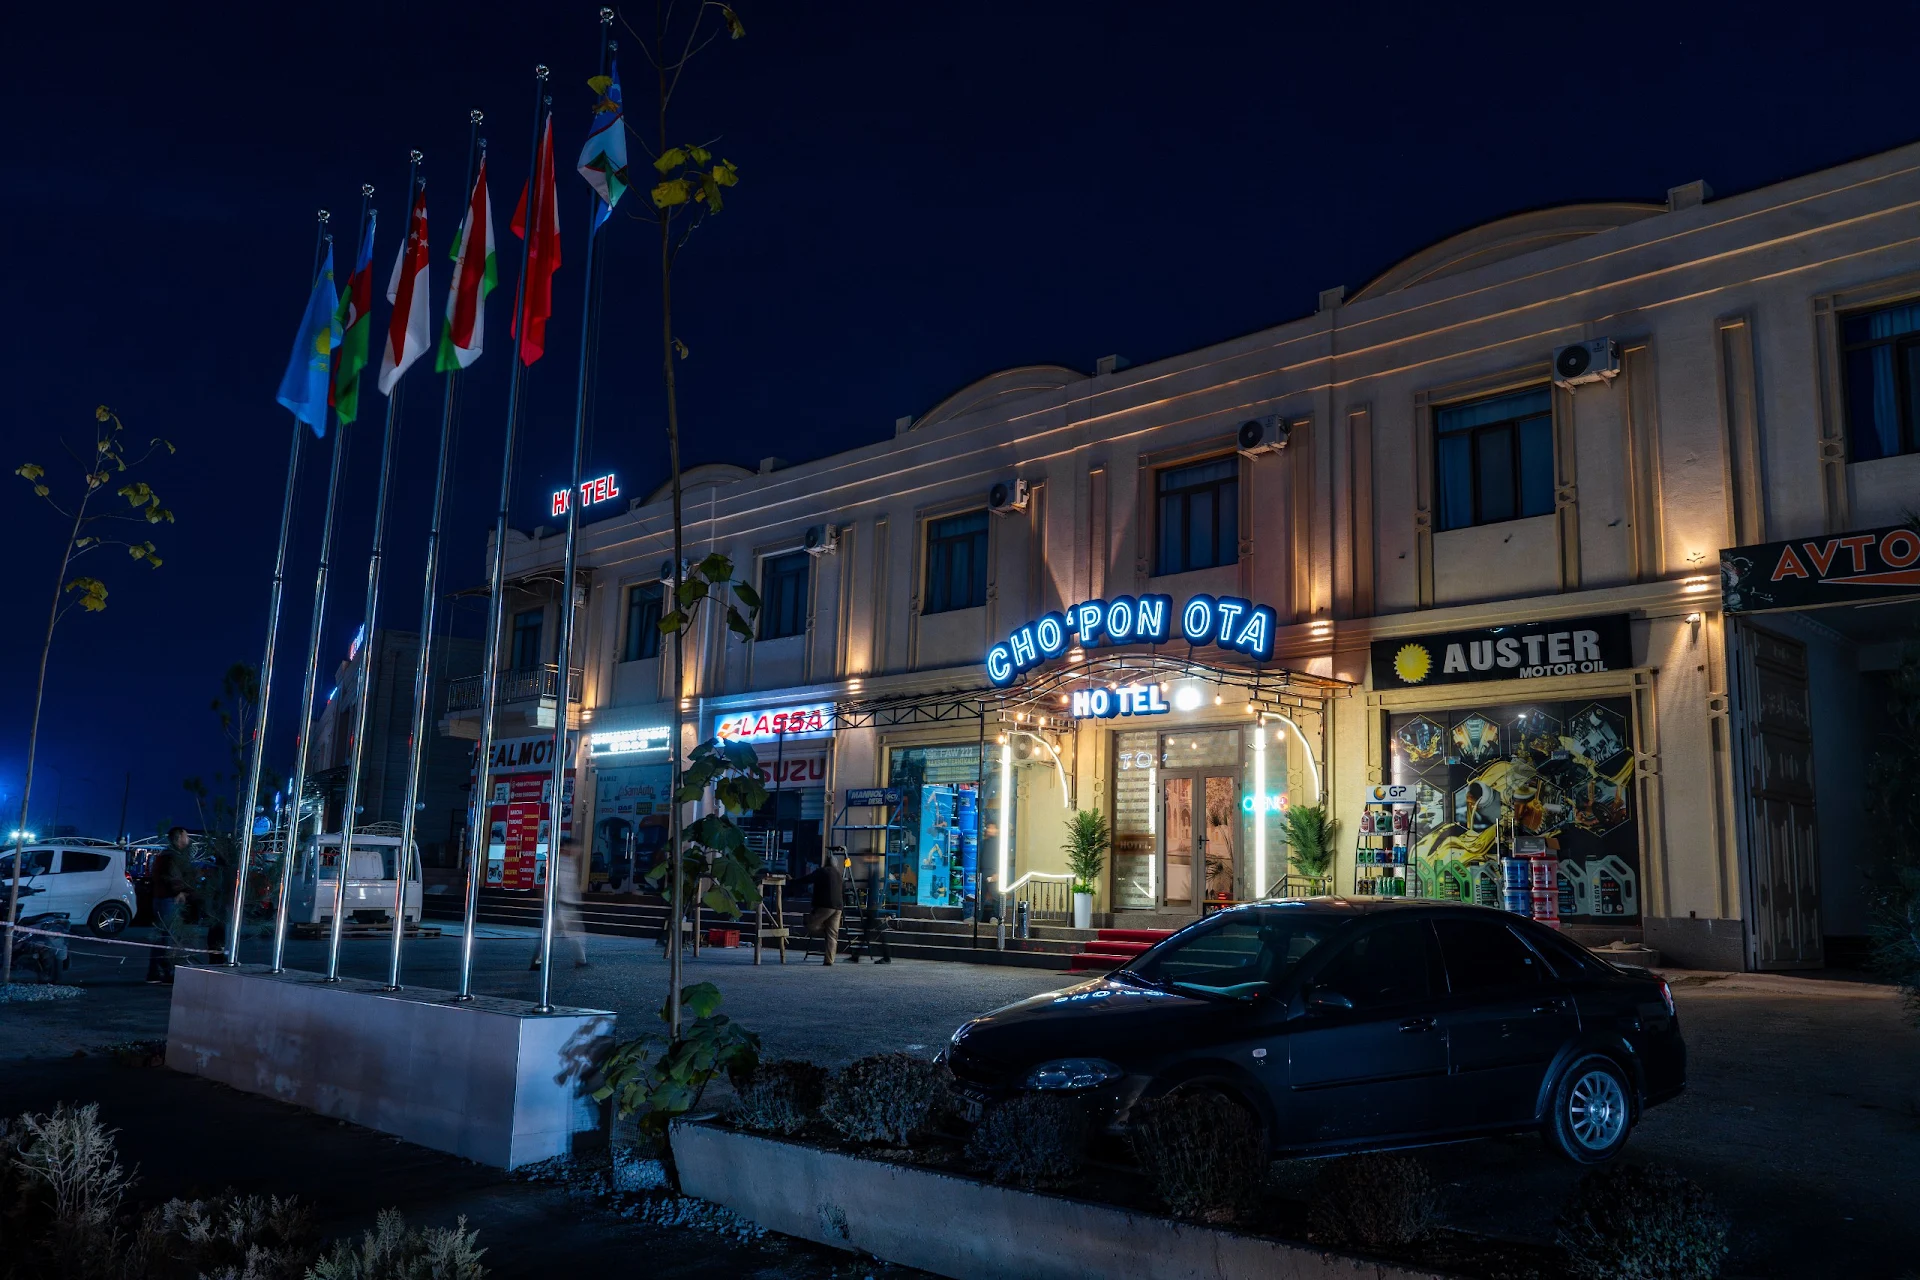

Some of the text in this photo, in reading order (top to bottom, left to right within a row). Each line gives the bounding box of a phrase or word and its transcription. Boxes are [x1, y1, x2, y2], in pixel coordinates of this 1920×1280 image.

[1770, 529, 1920, 582] AVTO
[1184, 599, 1269, 653] OTA
[1443, 629, 1601, 674] AUSTER
[1519, 660, 1608, 679] MOTOR OIL
[1072, 685, 1169, 717] HOTEL
[740, 708, 823, 736] LASSA
[851, 790, 884, 800] MANNOL
[1388, 785, 1407, 797] GP
[1593, 884, 1601, 913] AUSTER
